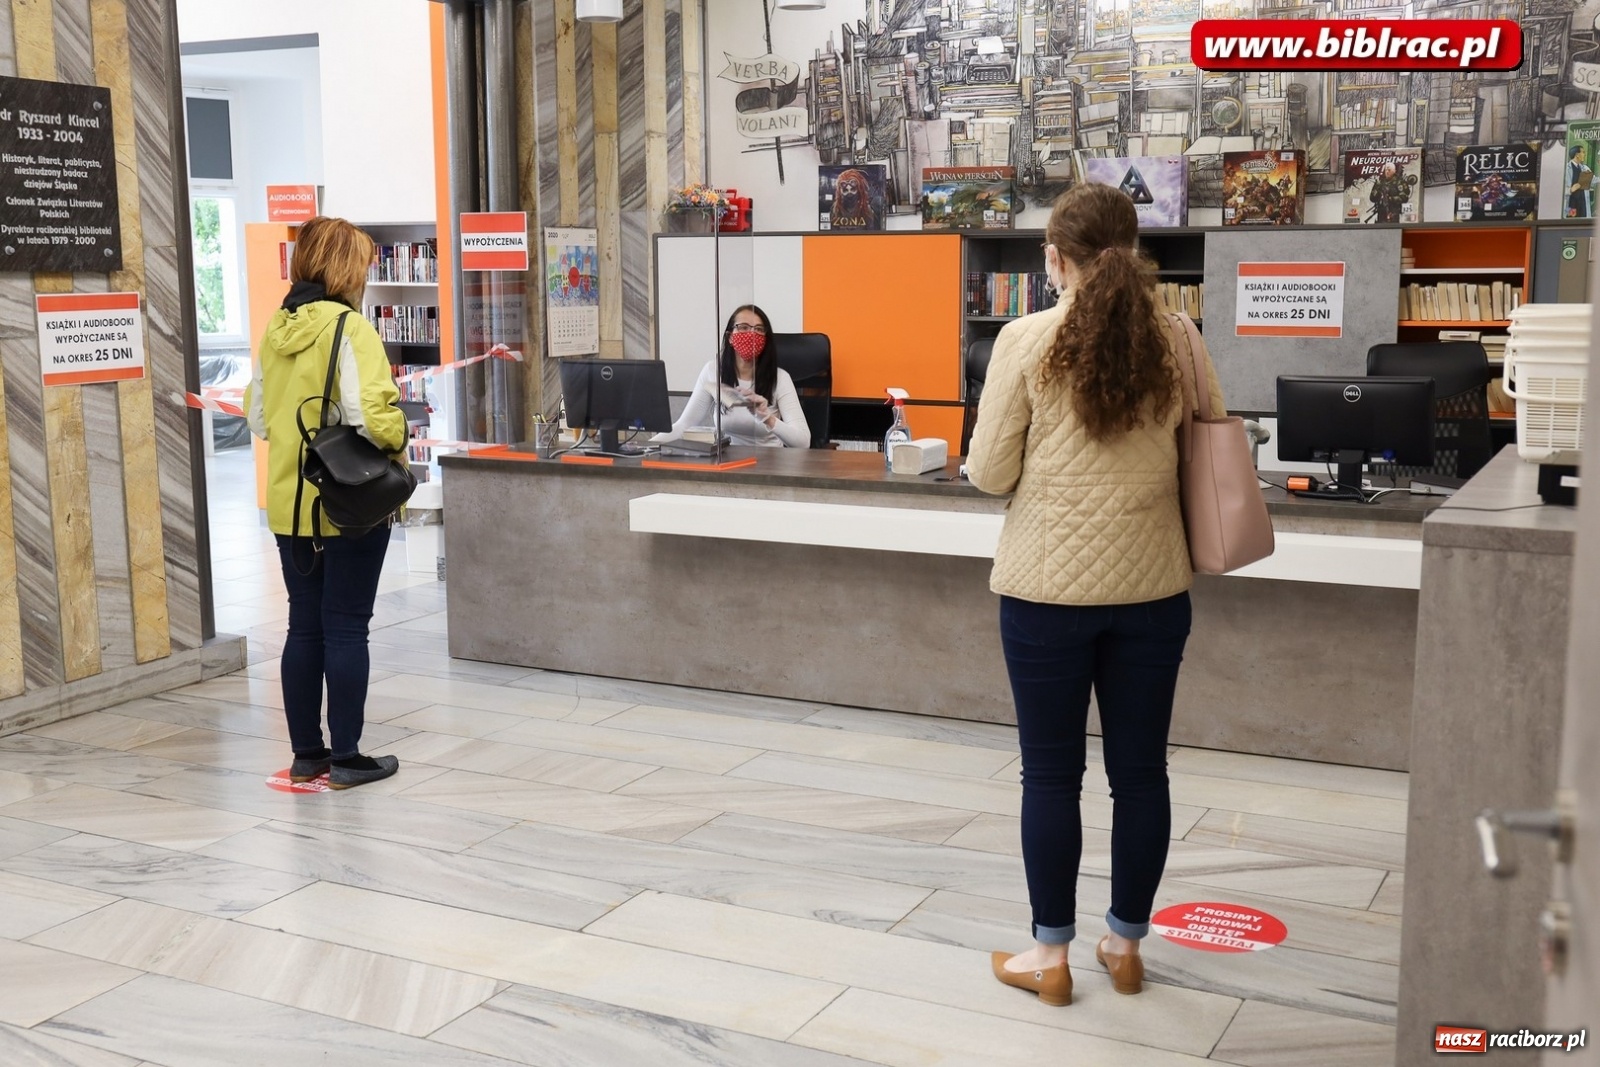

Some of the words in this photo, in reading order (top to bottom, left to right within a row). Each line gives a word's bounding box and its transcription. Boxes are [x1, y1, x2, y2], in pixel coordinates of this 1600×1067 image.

[733, 61, 788, 80] VERBA
[0, 108, 12, 121] dr
[19, 110, 61, 125] Ryszard
[68, 113, 100, 128] Kincel
[739, 114, 801, 131] VOLANT
[17, 127, 43, 140] 1933
[53, 130, 83, 143] 2004
[2, 153, 36, 165] Historyk,
[38, 155, 63, 166] literat,
[65, 158, 102, 169] publicysta,
[1350, 155, 1409, 166] NEUROSHIMA
[1463, 152, 1530, 175] RELIC
[14, 166, 61, 178] niestrudzony
[63, 168, 88, 178] badacz
[1361, 164, 1385, 175] HEX!
[930, 171, 956, 181] WOJNA
[24, 180, 52, 190] dziejów
[54, 179, 78, 191] Śląska
[6, 196, 35, 206] Członek
[37, 198, 67, 208] Związku
[69, 199, 103, 208] Literatów
[40, 209, 70, 218] Polskich
[833, 217, 867, 226] ZONA
[1, 224, 34, 235] Dyrektor
[36, 225, 78, 235] raciborskiej
[80, 226, 112, 235] biblioteki
[27, 236, 49, 244] latach
[51, 236, 68, 245] 1979
[75, 236, 96, 245] 2000
[463, 236, 523, 246] WYPOŻYCZENIA
[1245, 282, 1274, 292] KSIĄŻKI
[1282, 283, 1336, 291] AUDIOBOOKI
[1252, 294, 1314, 303] WYPOŻYCZANE
[1316, 295, 1327, 304] SĄ
[1247, 311, 1260, 319] NA
[1262, 311, 1288, 319] OKRES
[1290, 308, 1305, 319] 25
[1308, 309, 1331, 319] DNI
[46, 319, 76, 331] KSIĄŻKI
[83, 317, 134, 328] AUDIOBOOKI
[55, 332, 115, 344] WYPOŻYCZANE
[117, 332, 128, 342] SĄ
[53, 355, 65, 364] NA
[68, 353, 93, 363] OKRES
[95, 349, 109, 361] 25
[112, 347, 133, 360] DNI
[1194, 907, 1262, 922] PROSIMY
[1182, 913, 1262, 932] ZACHOWAJ
[1166, 929, 1203, 940] STAN
[1210, 936, 1255, 949] TUTAJ
